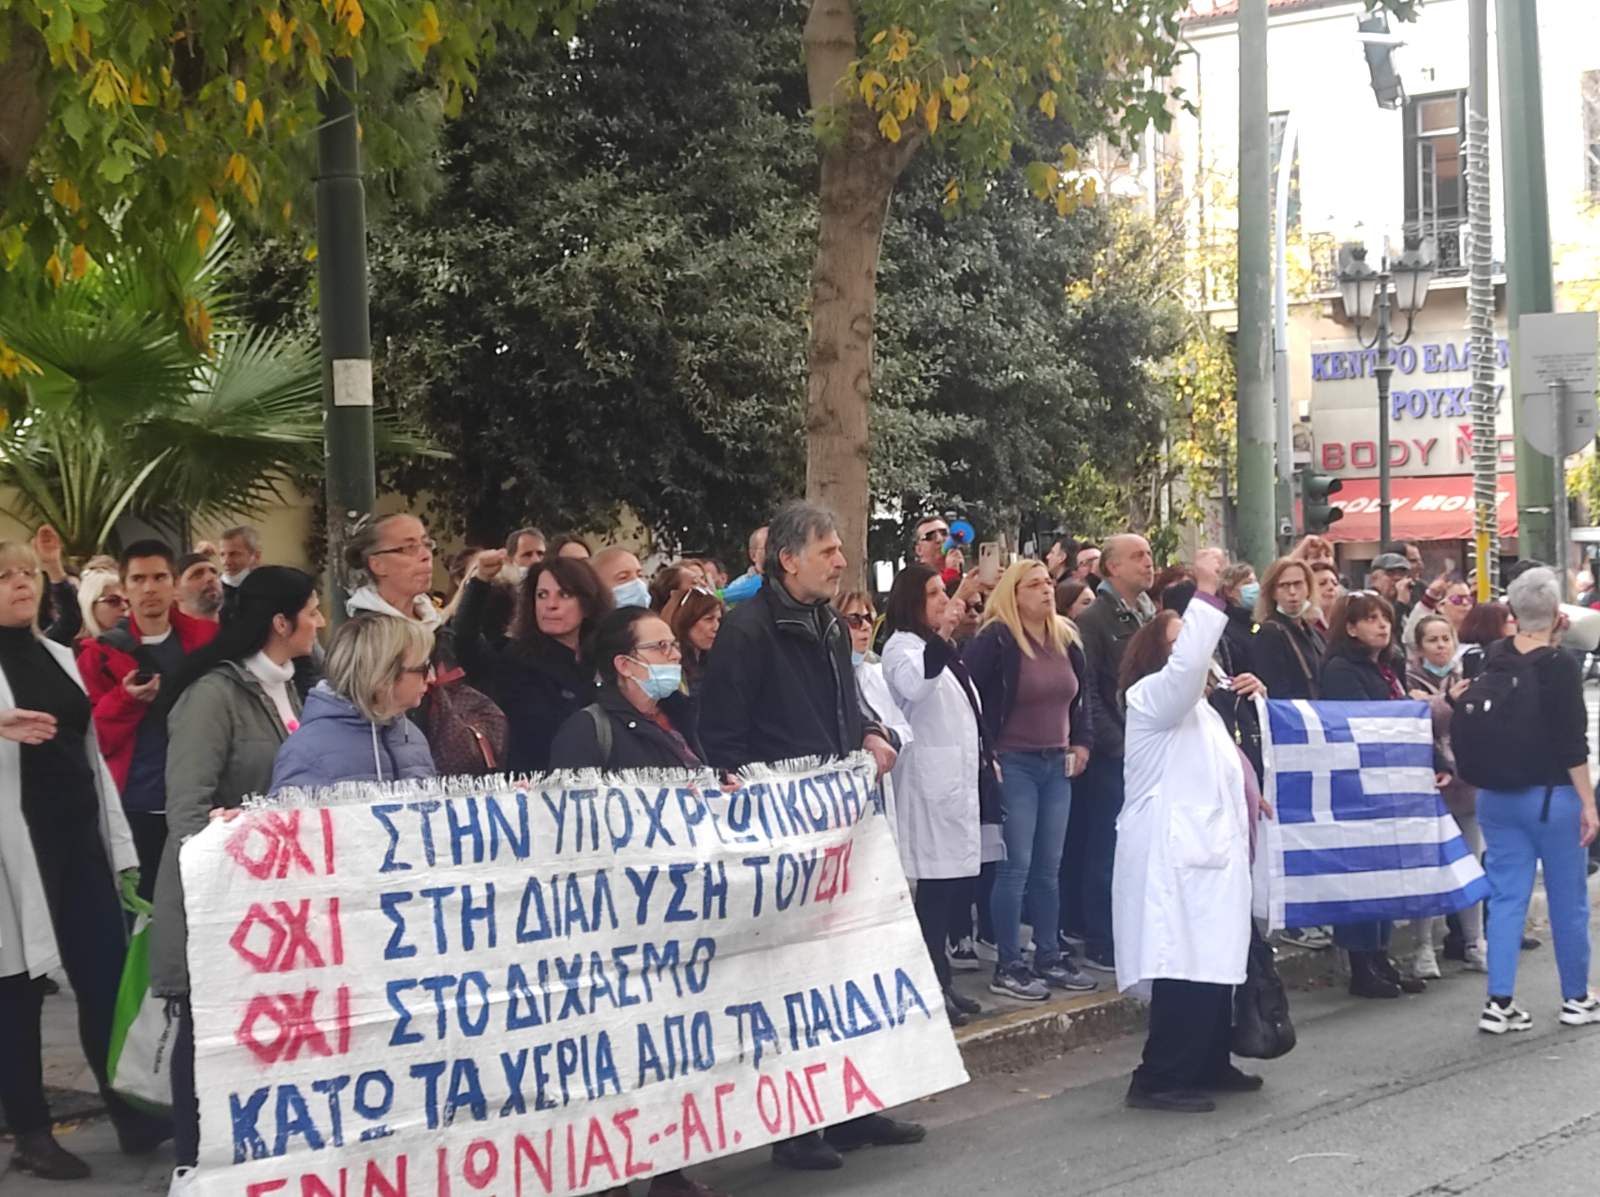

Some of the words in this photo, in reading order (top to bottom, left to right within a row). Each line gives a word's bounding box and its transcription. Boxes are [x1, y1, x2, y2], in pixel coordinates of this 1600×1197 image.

[1321, 437, 1438, 470] BODY
[225, 808, 337, 880] ΟΧΙ
[371, 790, 531, 873] ΣΤΗΝ
[229, 897, 344, 973] ΟΧΙ
[379, 882, 497, 960] ΣΤΗ
[516, 860, 728, 943] ΔΙΑΛΥΣΗ
[743, 847, 817, 918] ΤΟΥ
[236, 985, 351, 1064] ΟΧΙ
[386, 971, 490, 1047] ΣΤΟ
[506, 937, 717, 1031] ΔΙΧΑΣΜΟ
[228, 1070, 395, 1164] ΚΑΤΩ
[409, 1058, 488, 1130] ΤΑ
[499, 1031, 621, 1118] ΧΕΡΙΑ
[637, 1011, 717, 1088] ΑΠΟ
[724, 1001, 780, 1069] ΤΑ
[784, 967, 932, 1052] ΠΑΙΔΙΑ
[756, 1057, 886, 1136] ΟΛΓΑ
